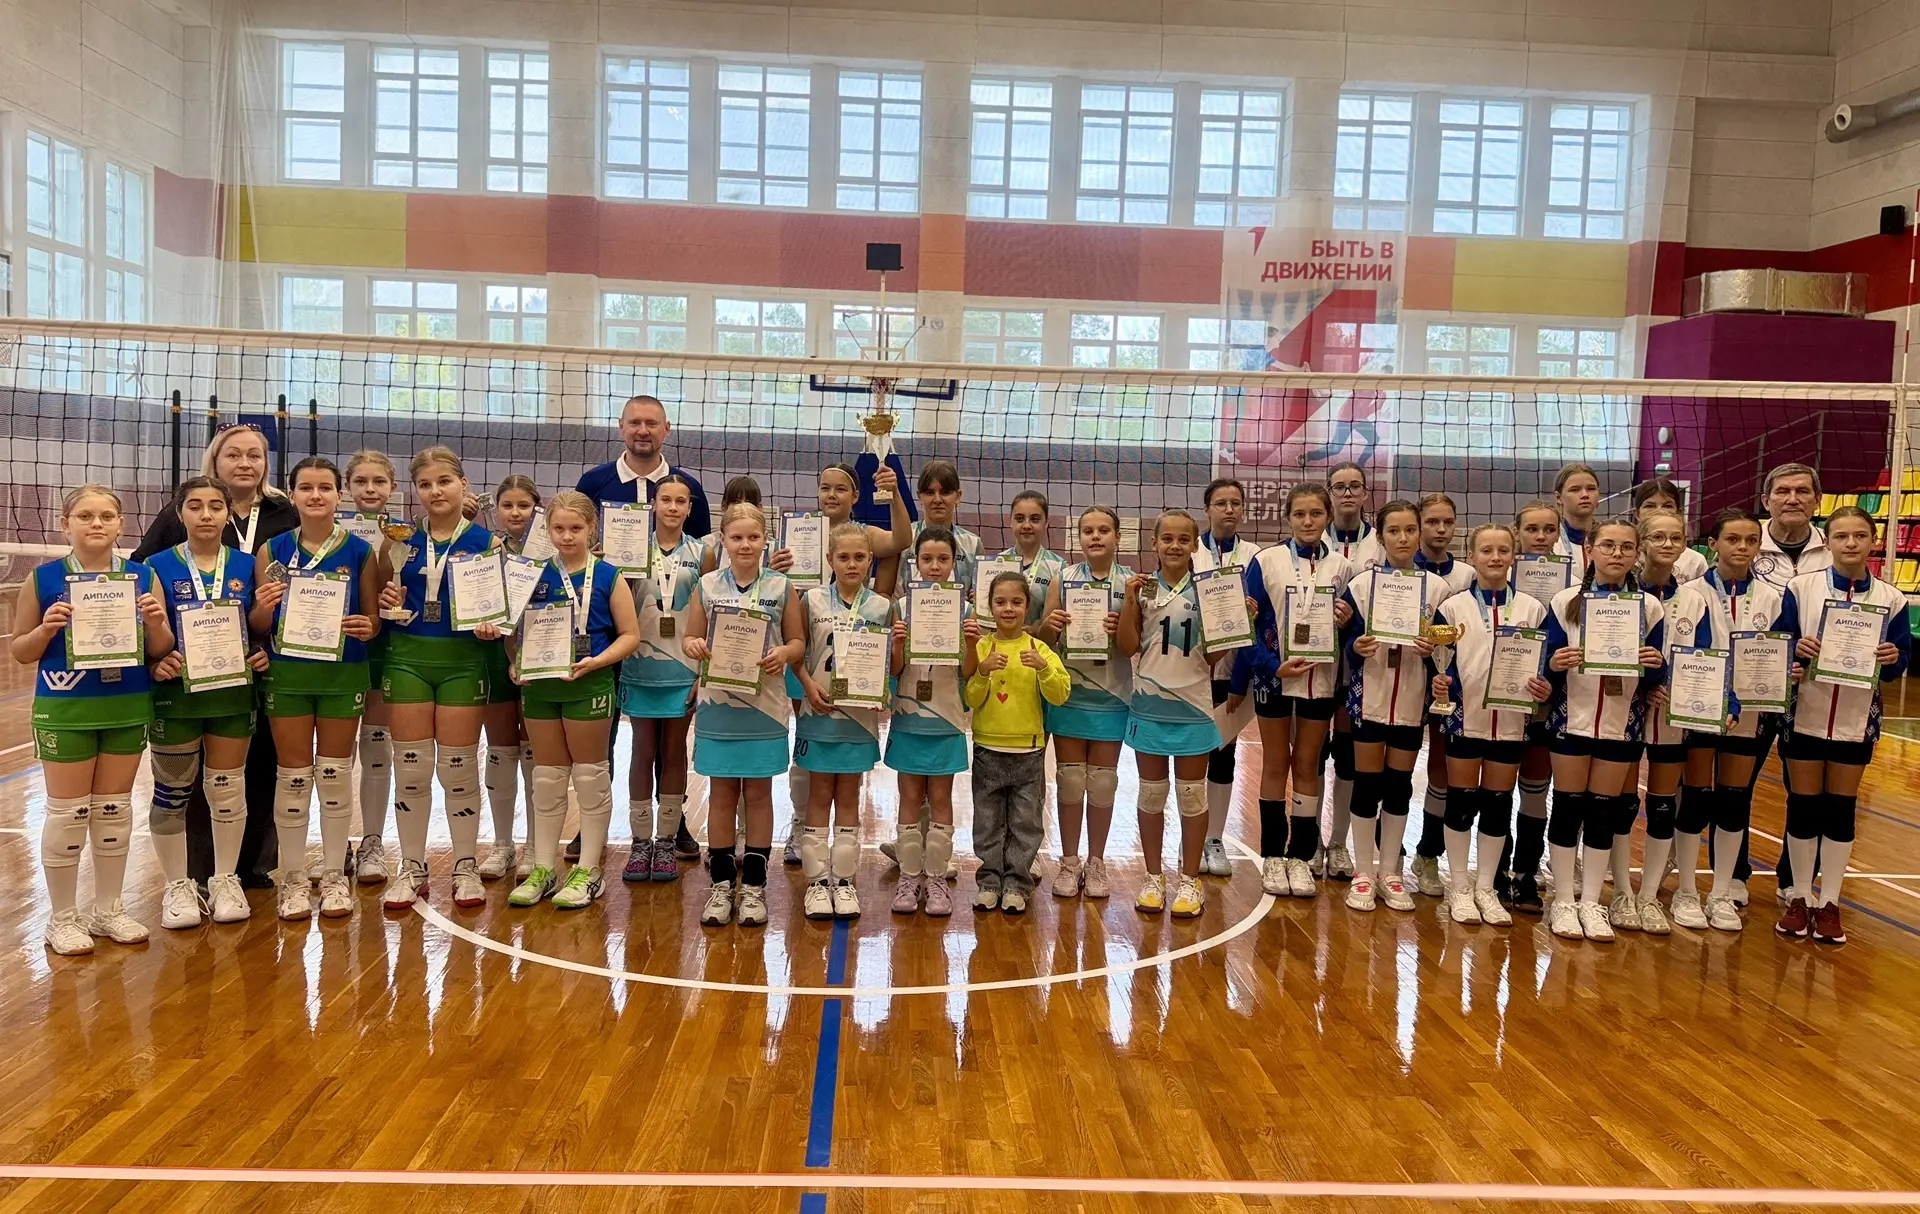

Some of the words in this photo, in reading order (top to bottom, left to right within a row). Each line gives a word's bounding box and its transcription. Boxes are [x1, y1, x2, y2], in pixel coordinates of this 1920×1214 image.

[1311, 239, 1375, 259] БЫТЬ
[1380, 241, 1394, 259] В
[1261, 261, 1392, 283] ДВИЖЕНИИ
[463, 564, 495, 577] ДИПЛОМ
[1525, 569, 1558, 578] ДИПЛОМ
[300, 587, 336, 597] ДИПЛОМ
[1204, 583, 1235, 596] ДИПЛОМ
[1382, 582, 1413, 592] ДИПЛОМ
[83, 591, 124, 601] ДИПЛОМ
[1072, 597, 1101, 605] ДИПЛОМ
[920, 598, 952, 606] ДИПЛОМ
[1595, 608, 1631, 617] ДИПЛОМ
[192, 616, 230, 628] ДИПЛОМ
[533, 616, 564, 625] ДИПЛОМ
[1835, 617, 1872, 630] ДИПЛОМ
[724, 624, 758, 634] ДИПЛОМ
[1159, 615, 1192, 658] 11
[848, 641, 879, 649] ДИПЛОМ
[1501, 646, 1532, 655] ДИПЛОМ
[1743, 646, 1778, 656] ДИПЛОМ
[1681, 662, 1716, 673] ДИПЛОМ
[592, 695, 607, 709] 12
